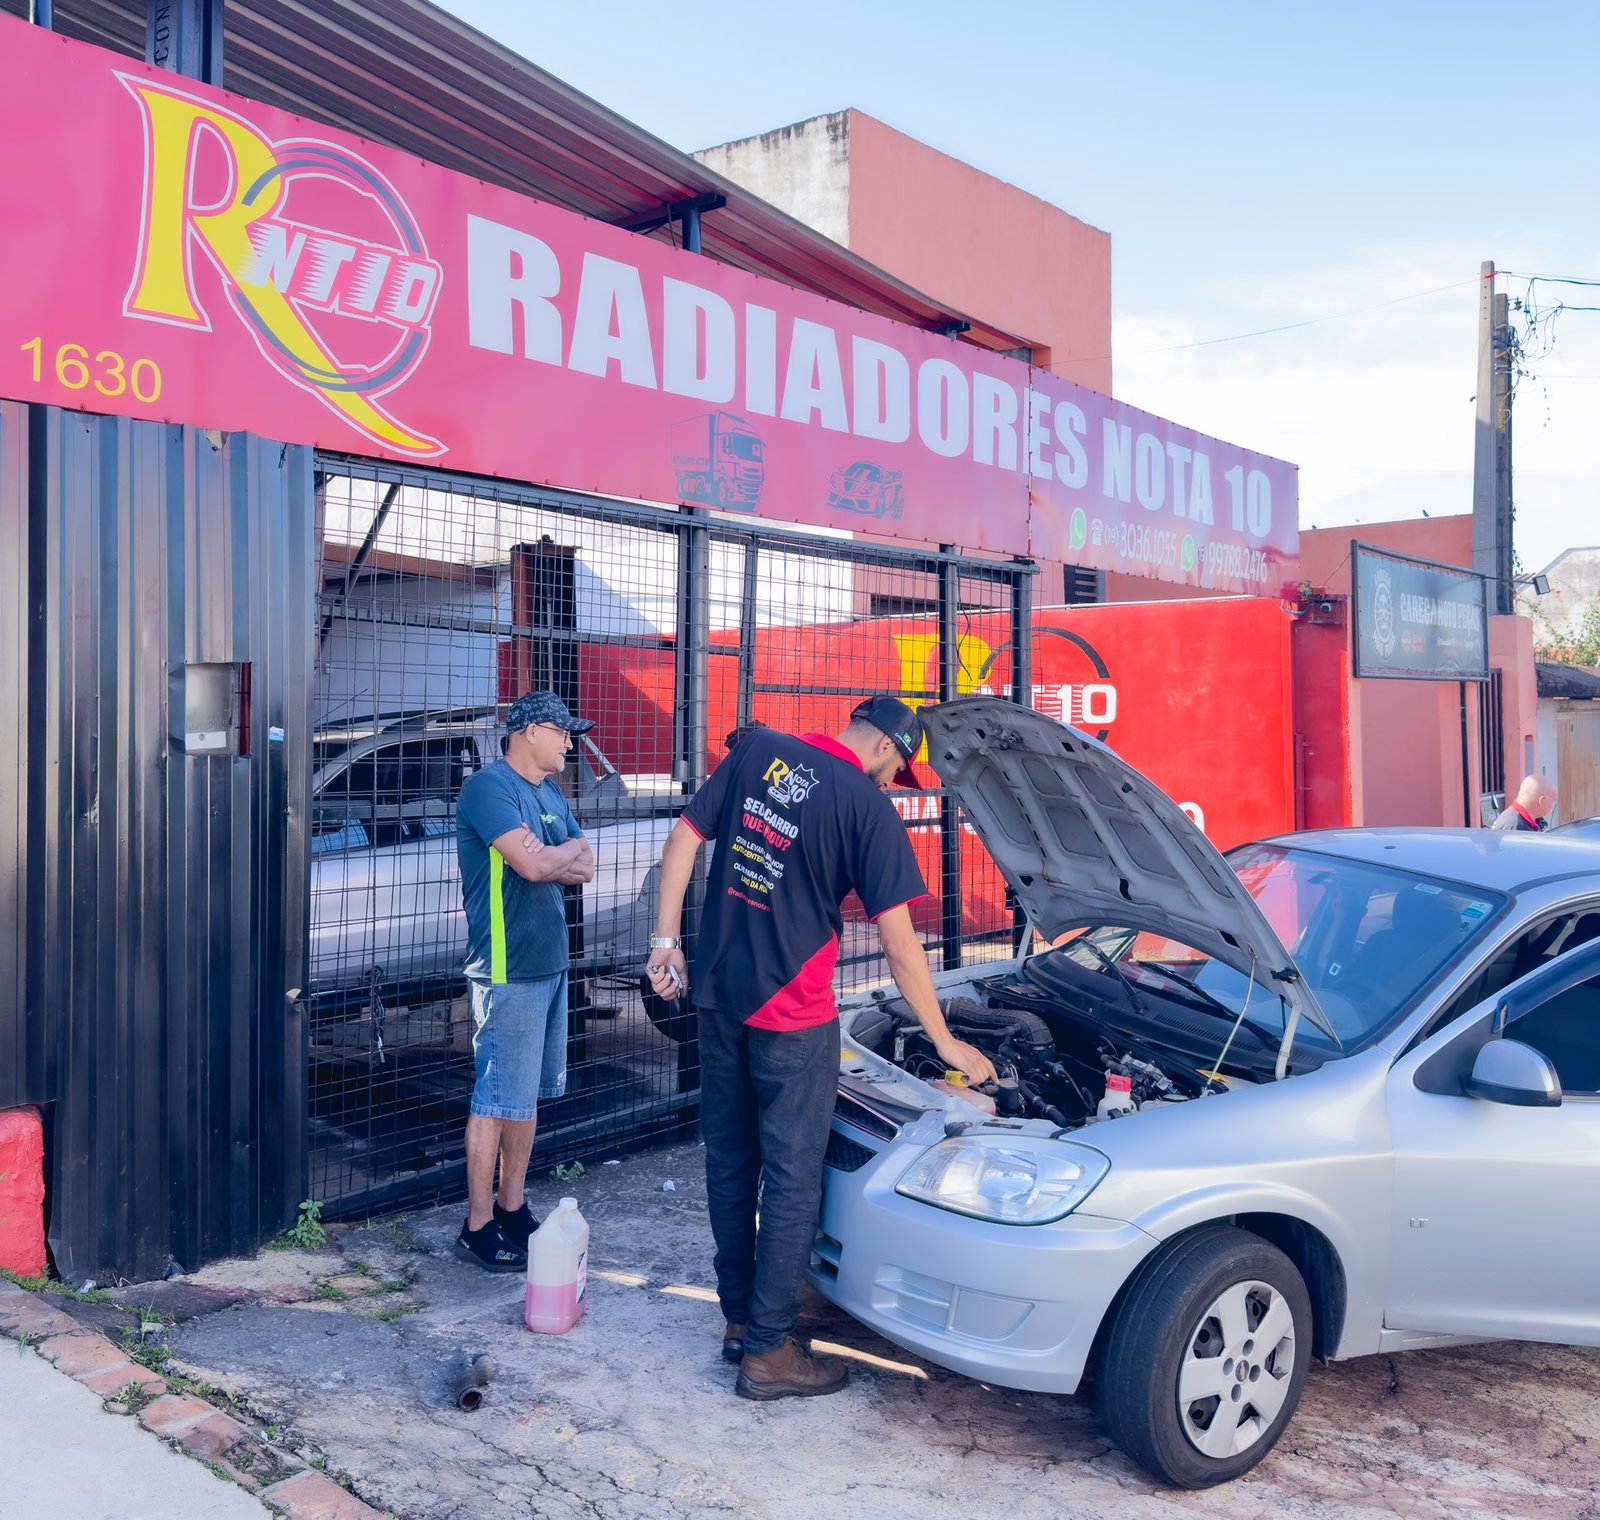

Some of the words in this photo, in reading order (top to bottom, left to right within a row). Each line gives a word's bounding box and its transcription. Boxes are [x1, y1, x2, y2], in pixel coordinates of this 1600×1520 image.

[20, 335, 162, 403] 1630
[466, 213, 1089, 490] RADIADORES
[1102, 416, 1215, 526] NOTA
[1224, 464, 1272, 538] 10
[763, 807, 799, 839] CARRO
